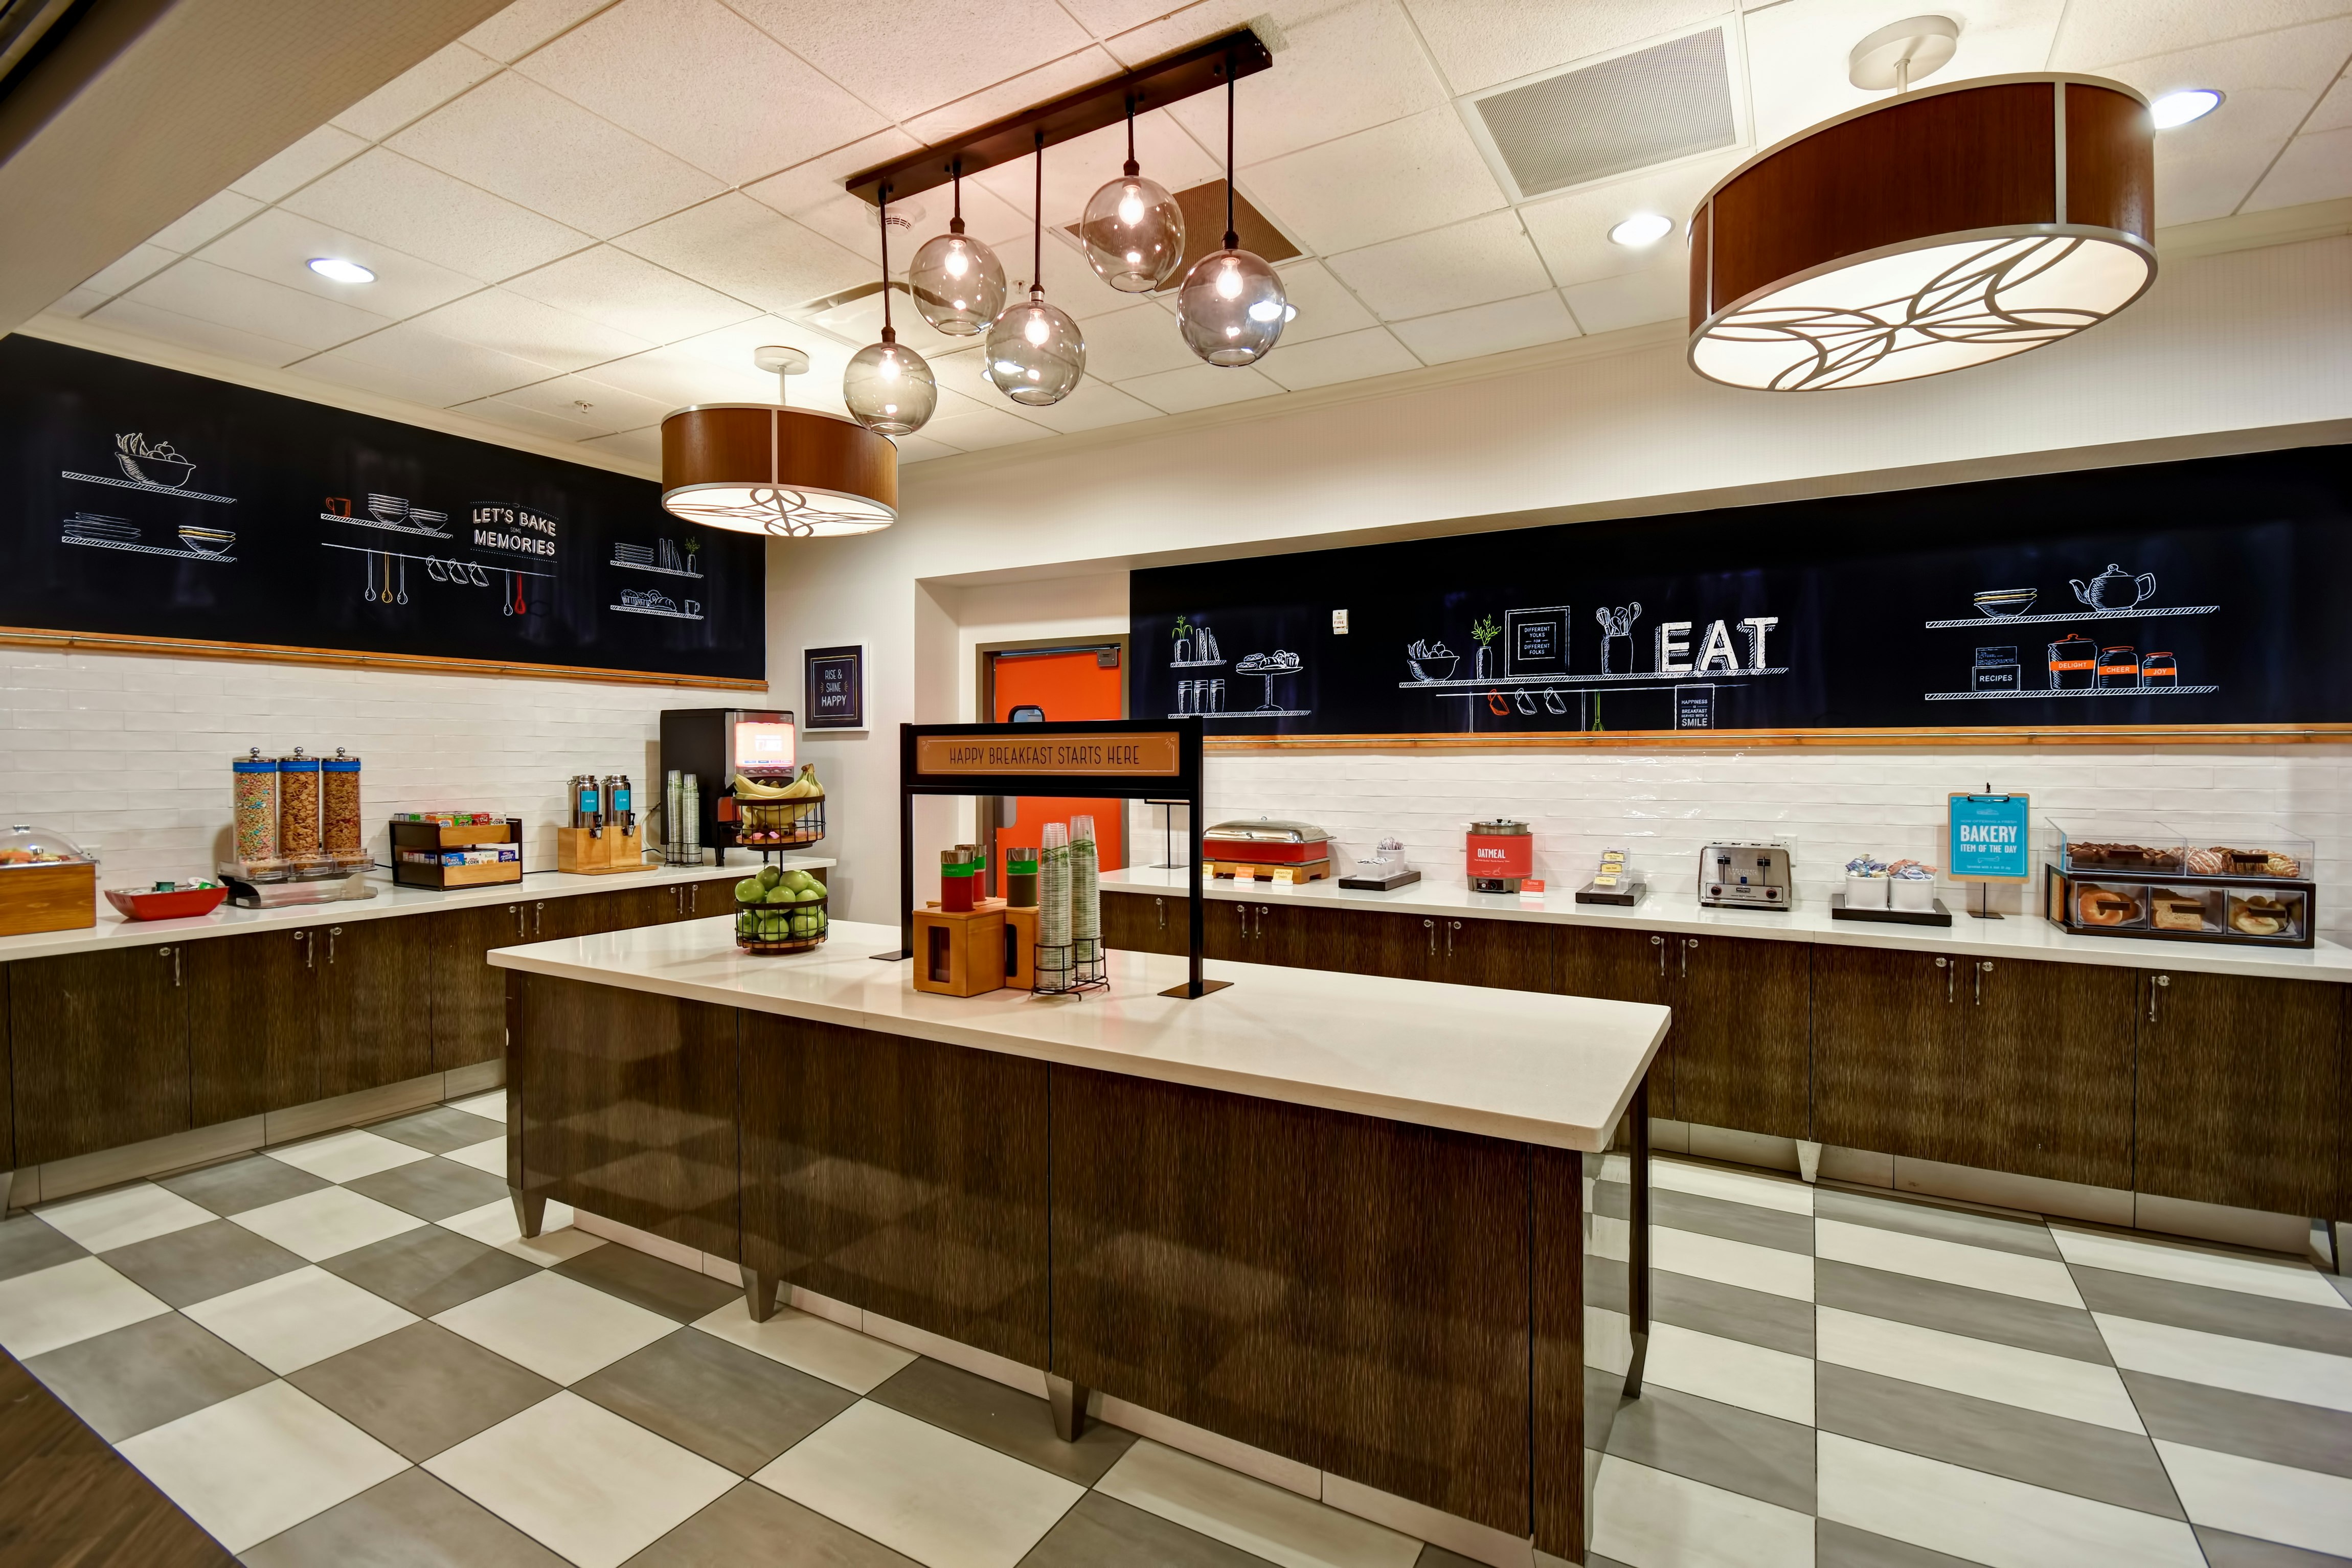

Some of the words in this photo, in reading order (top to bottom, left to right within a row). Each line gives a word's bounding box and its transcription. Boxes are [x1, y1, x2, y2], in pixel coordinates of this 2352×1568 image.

[473, 508, 513, 524] LET'S
[519, 512, 556, 537] BAKE
[474, 529, 555, 556] MEMORIES
[1657, 617, 1778, 673] EAT
[825, 670, 836, 679] RISE
[838, 669, 842, 679] &
[826, 682, 841, 692] SHINE
[822, 695, 847, 707] HAPPY
[1682, 718, 1708, 726] SMILE
[950, 747, 984, 764] HAPPY
[989, 746, 1053, 764] BREAKFAST
[1058, 746, 1101, 764] STARTS
[1108, 746, 1139, 764] HERE
[1960, 825, 2017, 843] BAKERY
[1477, 848, 1506, 858] OATMEAL
[1960, 844, 1976, 852] ITEM
[1989, 845, 2002, 853] THE
[2004, 845, 2017, 853] DAY
